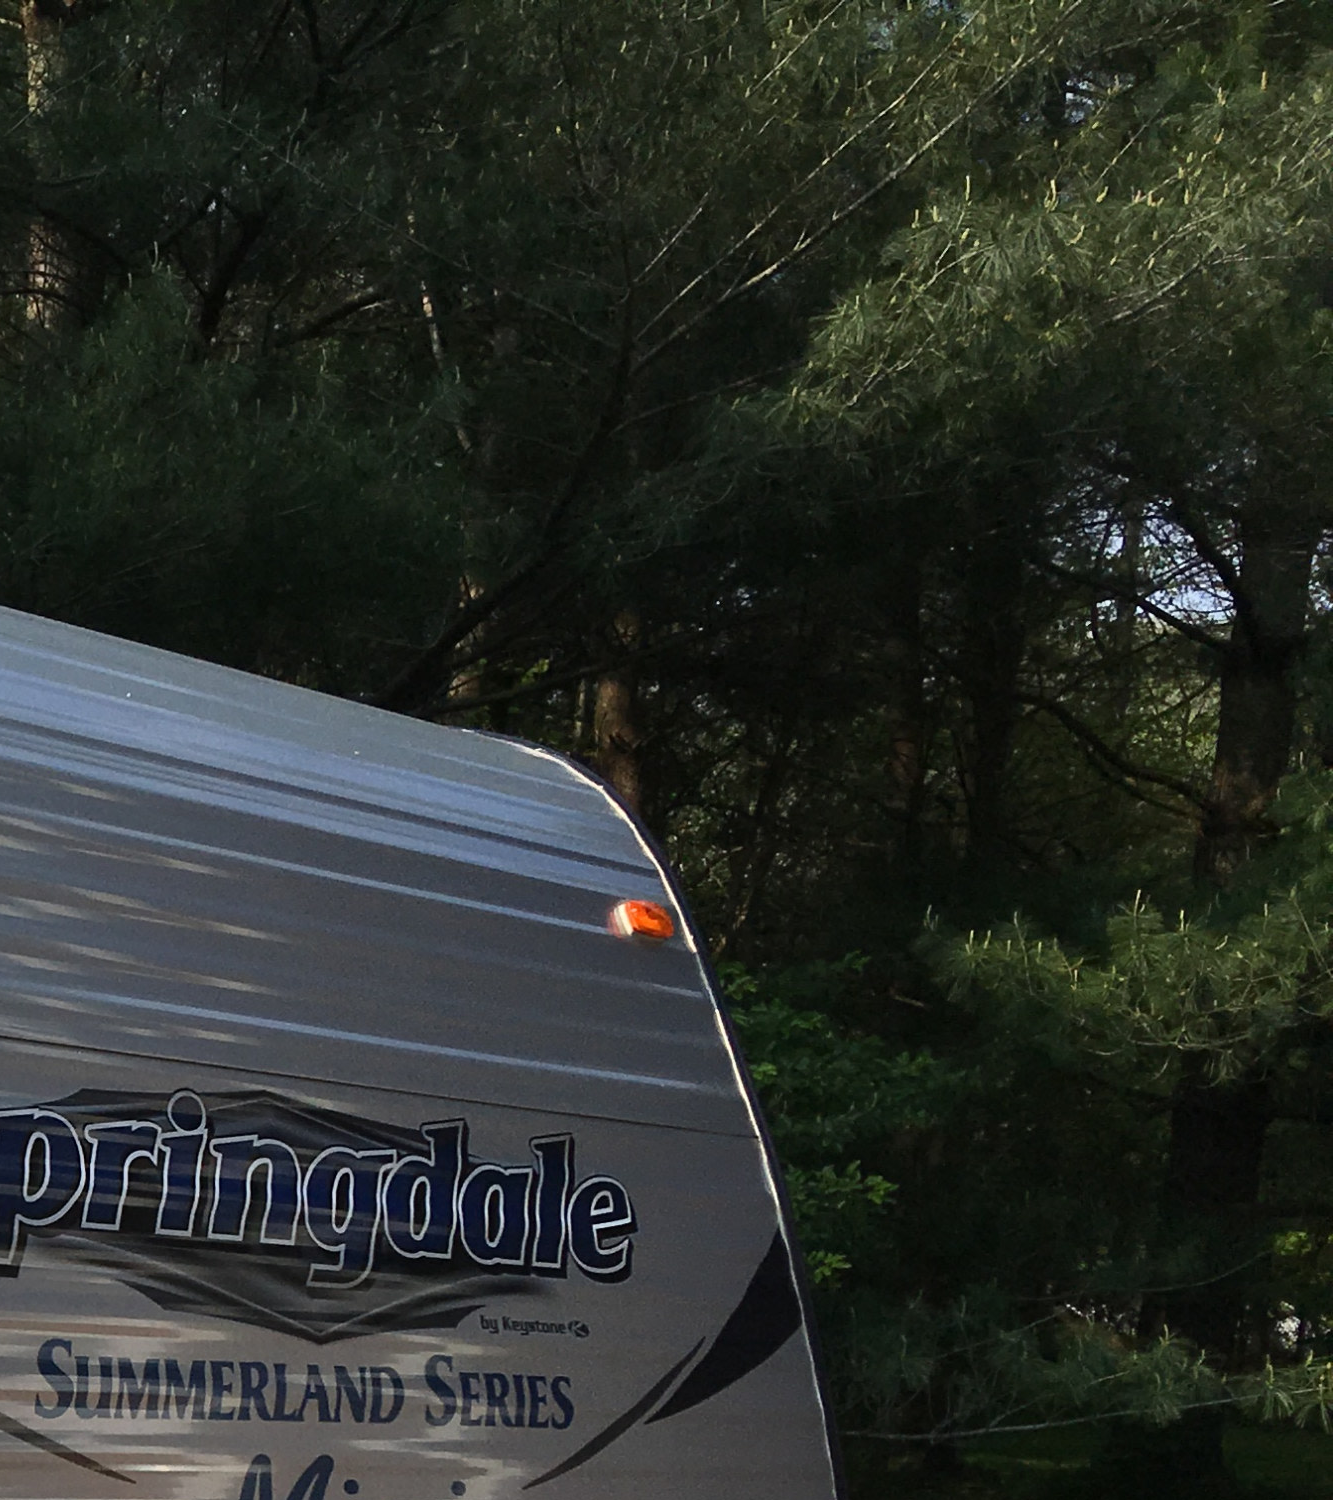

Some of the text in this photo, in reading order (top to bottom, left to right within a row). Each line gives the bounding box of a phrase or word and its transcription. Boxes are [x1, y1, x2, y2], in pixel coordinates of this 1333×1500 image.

[480, 1314, 567, 1336] by Keystone
[34, 1338, 576, 1430] SUMMERLAND SERIES
